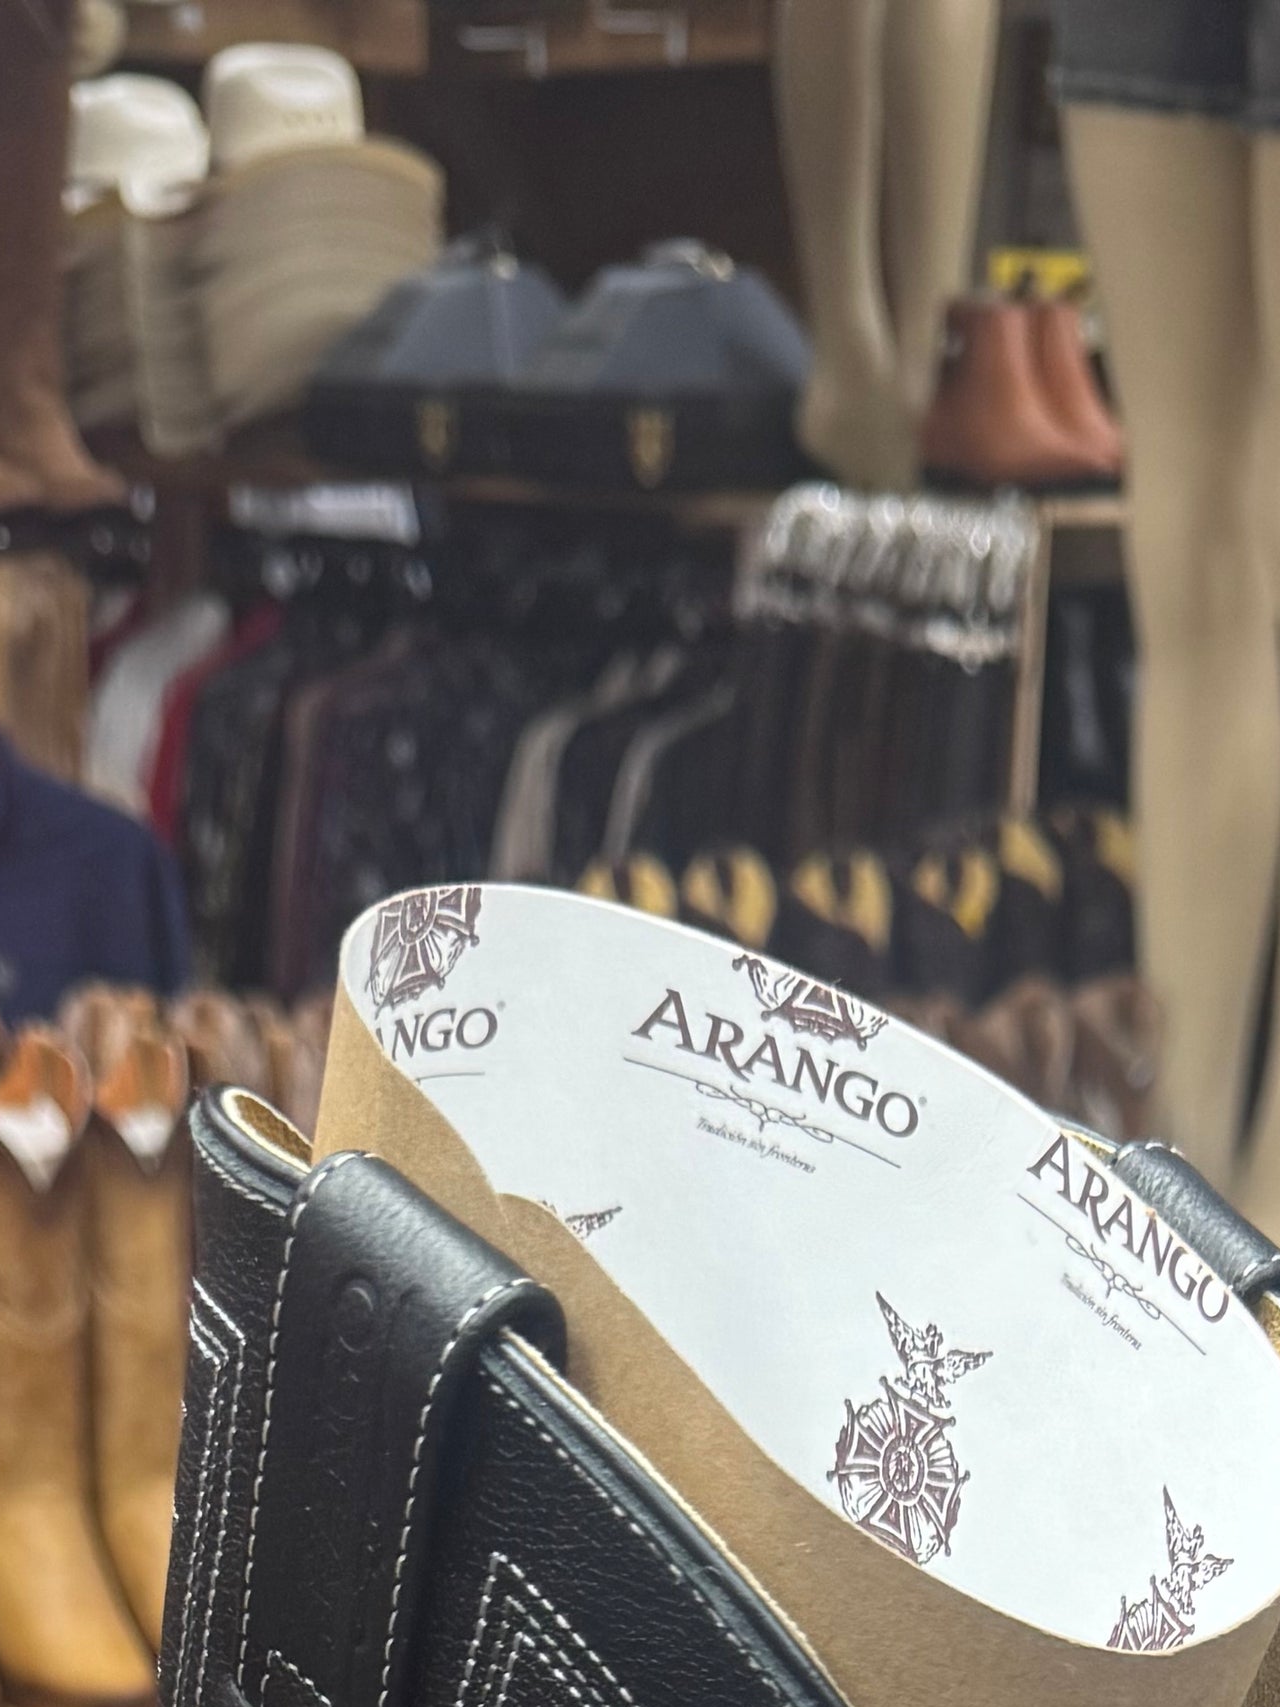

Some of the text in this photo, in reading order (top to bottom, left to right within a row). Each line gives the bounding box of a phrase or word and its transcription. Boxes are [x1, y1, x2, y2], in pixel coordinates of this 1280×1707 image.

[375, 1007, 499, 1062] NGO
[629, 987, 920, 1139] ARANGO
[1025, 1133, 1231, 1325] ARANGO
